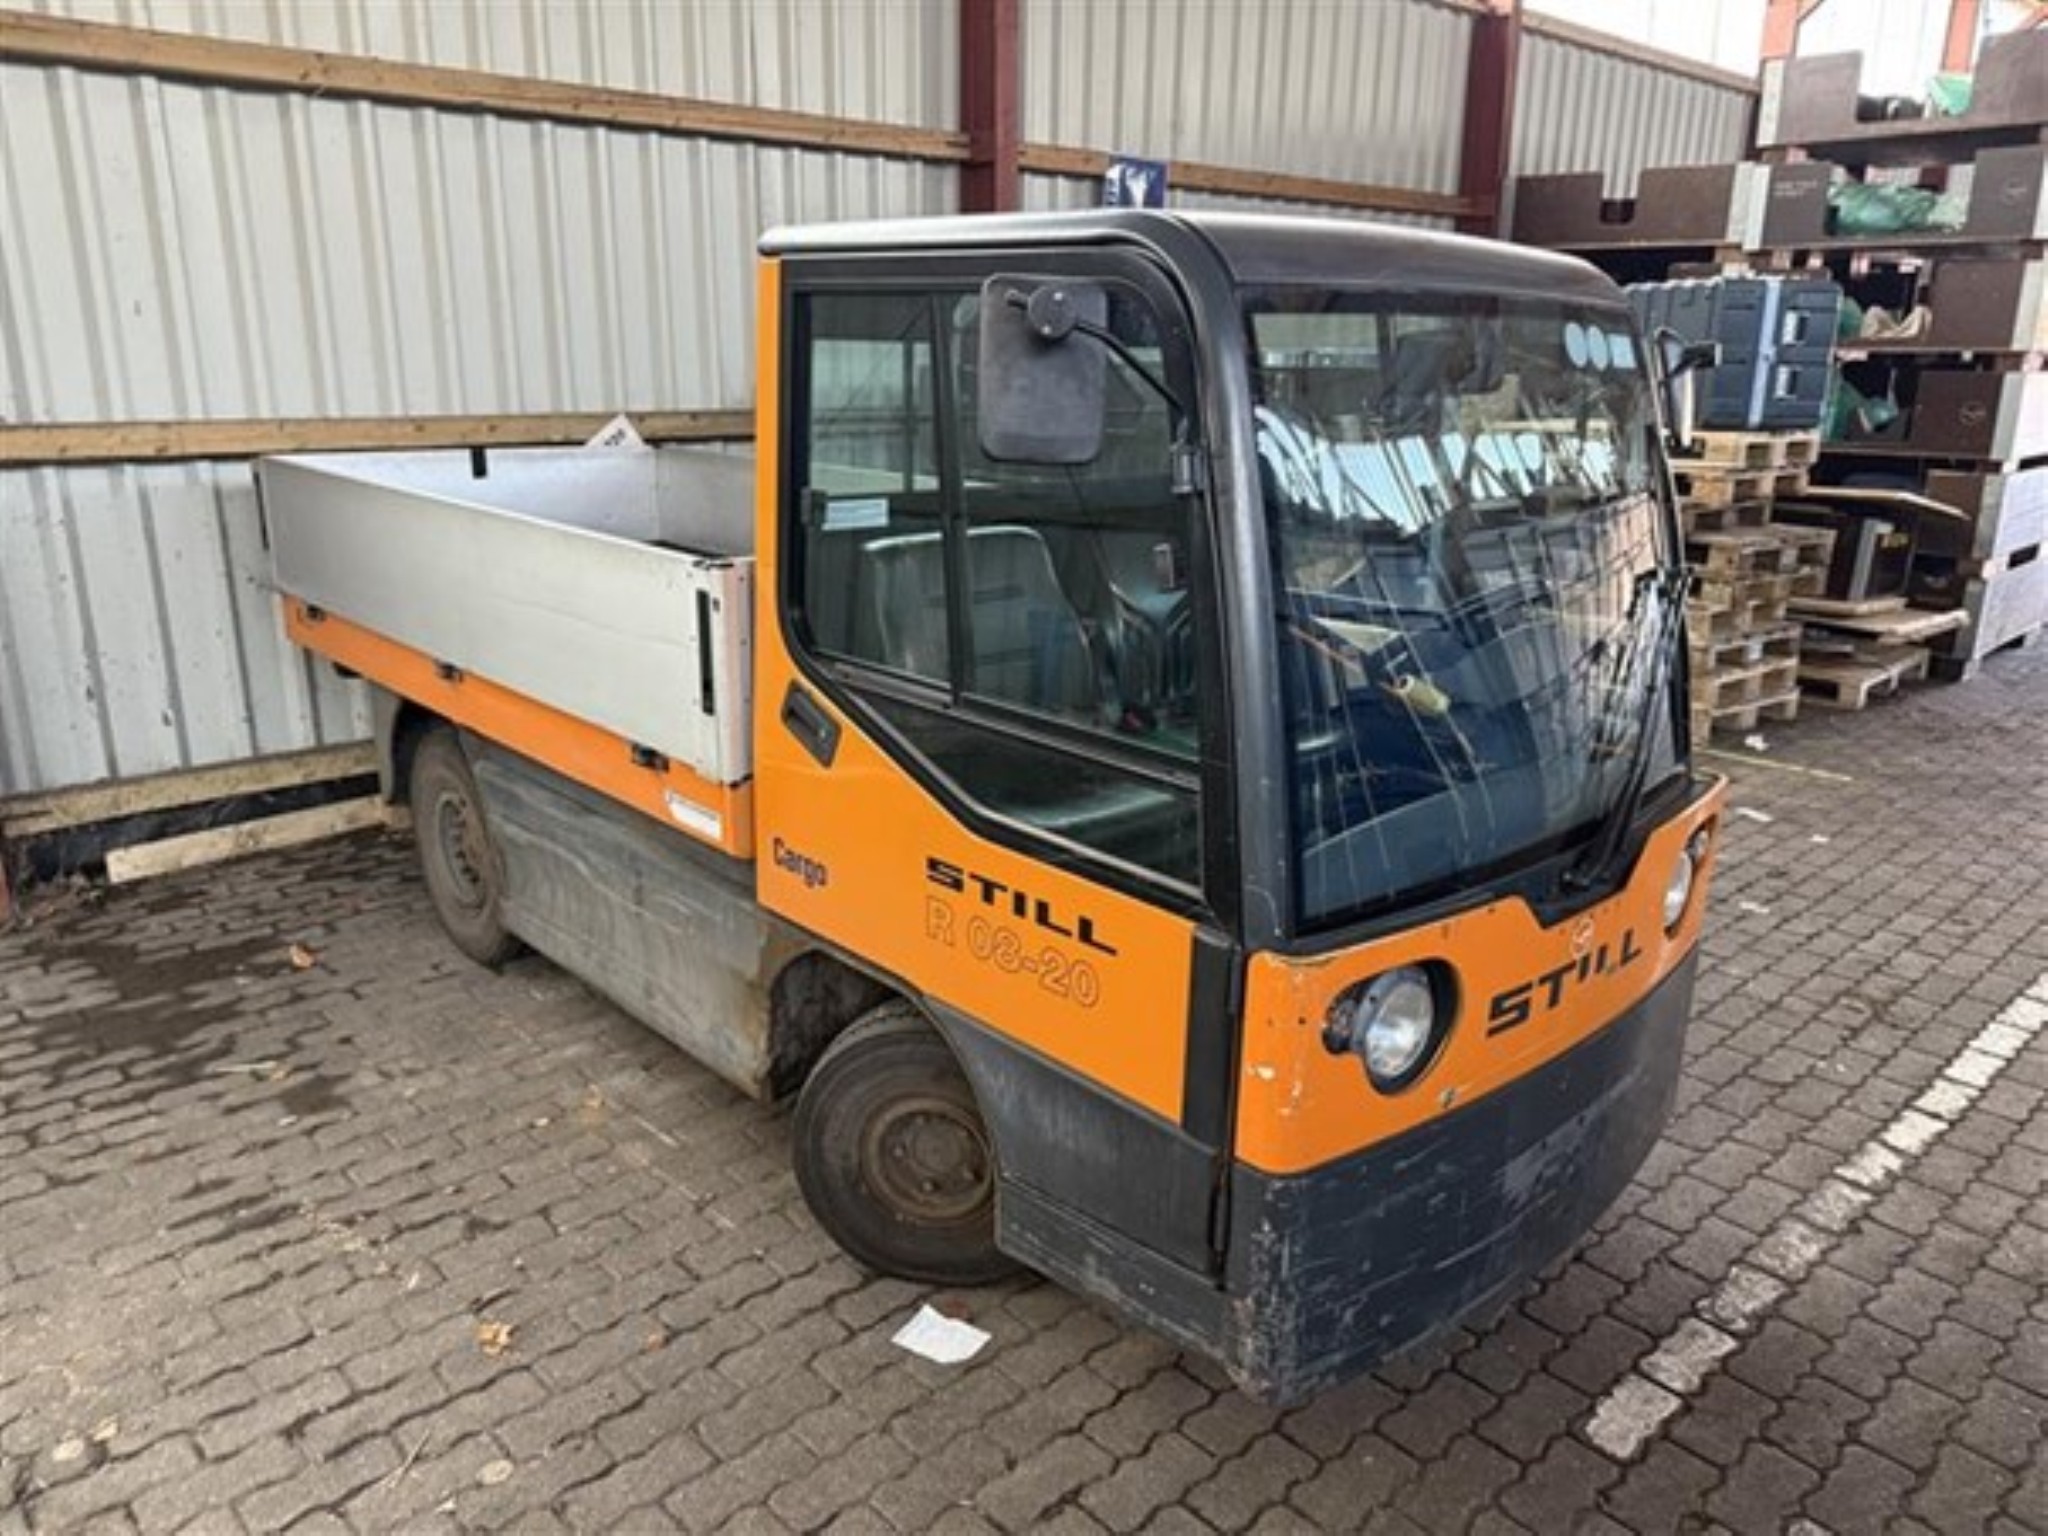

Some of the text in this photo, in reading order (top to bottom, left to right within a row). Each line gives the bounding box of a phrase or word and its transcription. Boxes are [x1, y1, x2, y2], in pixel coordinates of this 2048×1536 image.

[773, 836, 828, 889] Cargo
[926, 856, 1119, 956] STILL
[926, 895, 1099, 1008] R 08-20
[1486, 928, 1643, 1039] STILL
